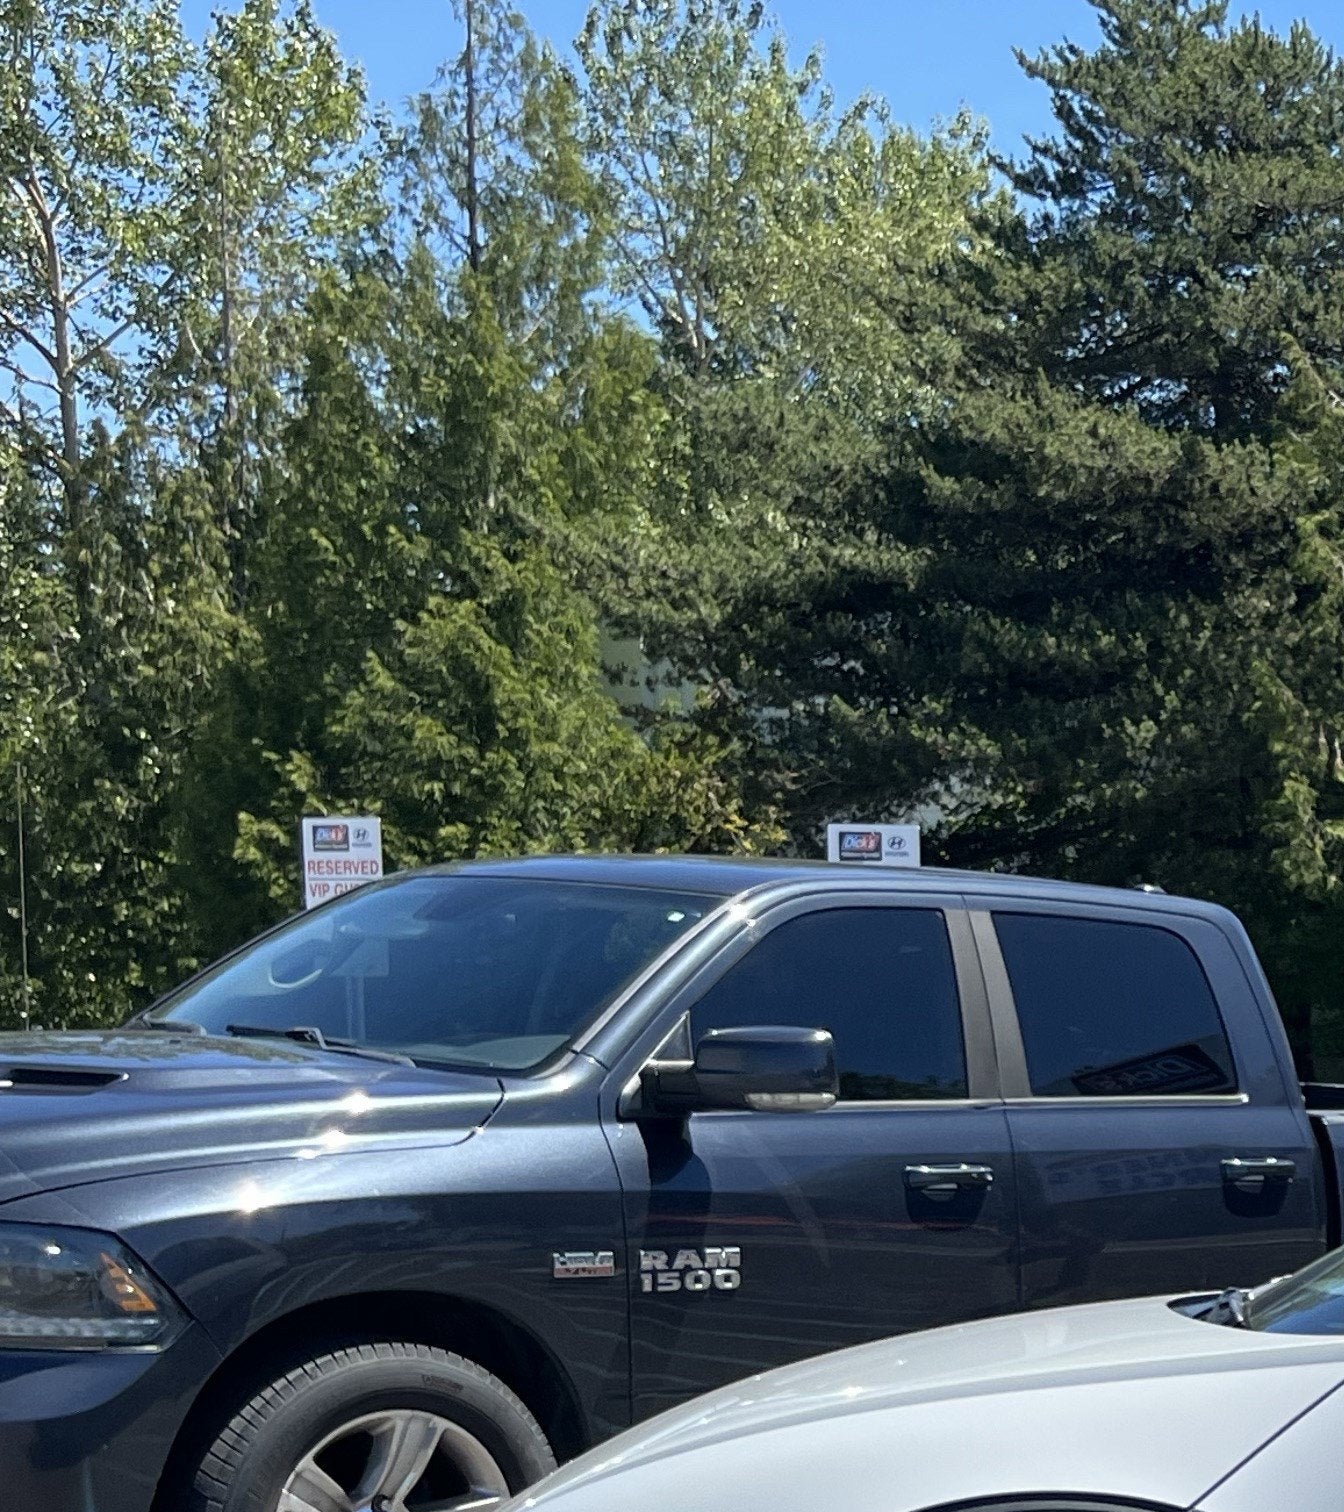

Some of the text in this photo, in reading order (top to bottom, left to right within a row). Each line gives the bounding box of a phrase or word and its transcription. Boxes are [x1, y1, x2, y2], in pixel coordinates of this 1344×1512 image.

[307, 859, 380, 876] RESERVED
[308, 883, 331, 899] VIP
[639, 1246, 741, 1270] RAM
[640, 1268, 741, 1293] 1500
